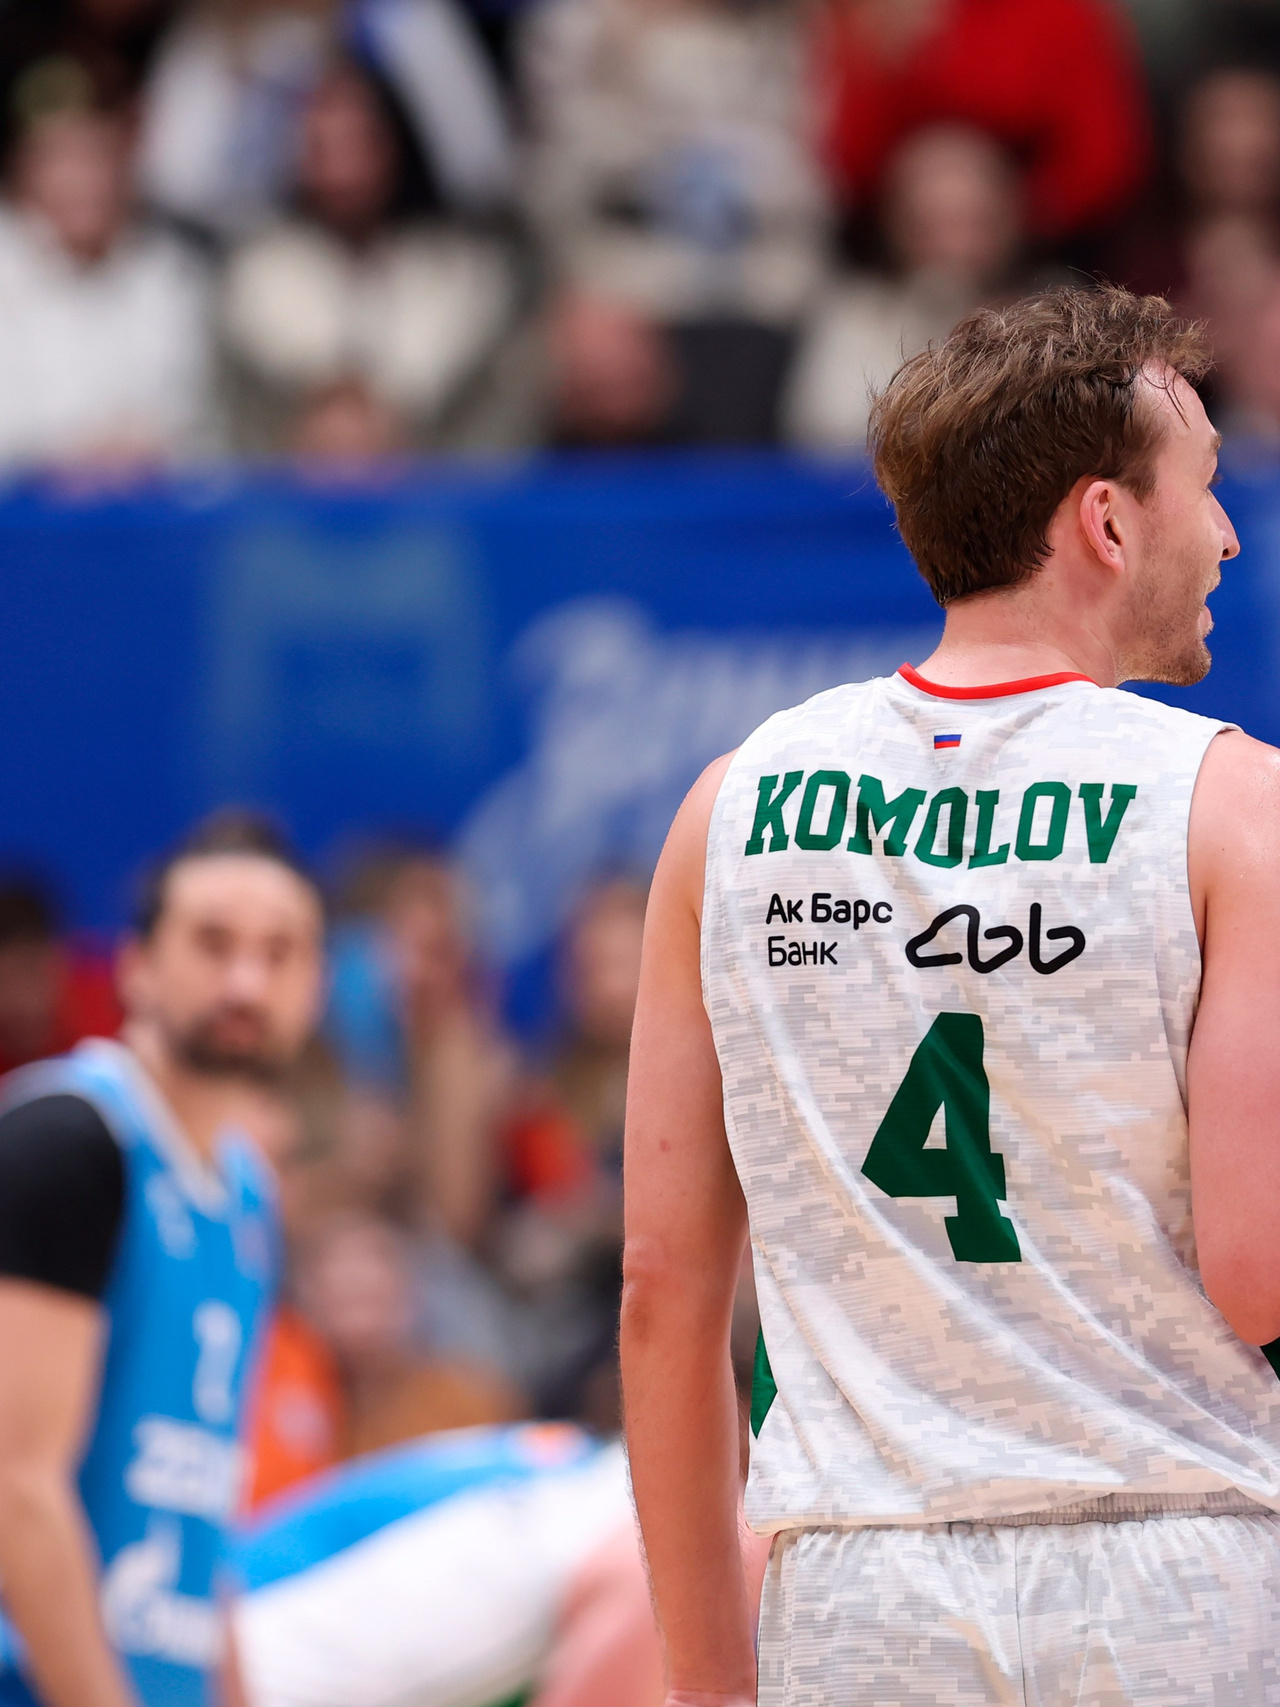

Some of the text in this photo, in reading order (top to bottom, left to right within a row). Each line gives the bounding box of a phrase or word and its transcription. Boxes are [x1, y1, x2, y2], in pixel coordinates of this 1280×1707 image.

[744, 769, 1138, 870] KOMOLOV
[766, 893, 893, 930] Ак Барс
[768, 936, 838, 967] Банк
[861, 1011, 1022, 1263] 4
